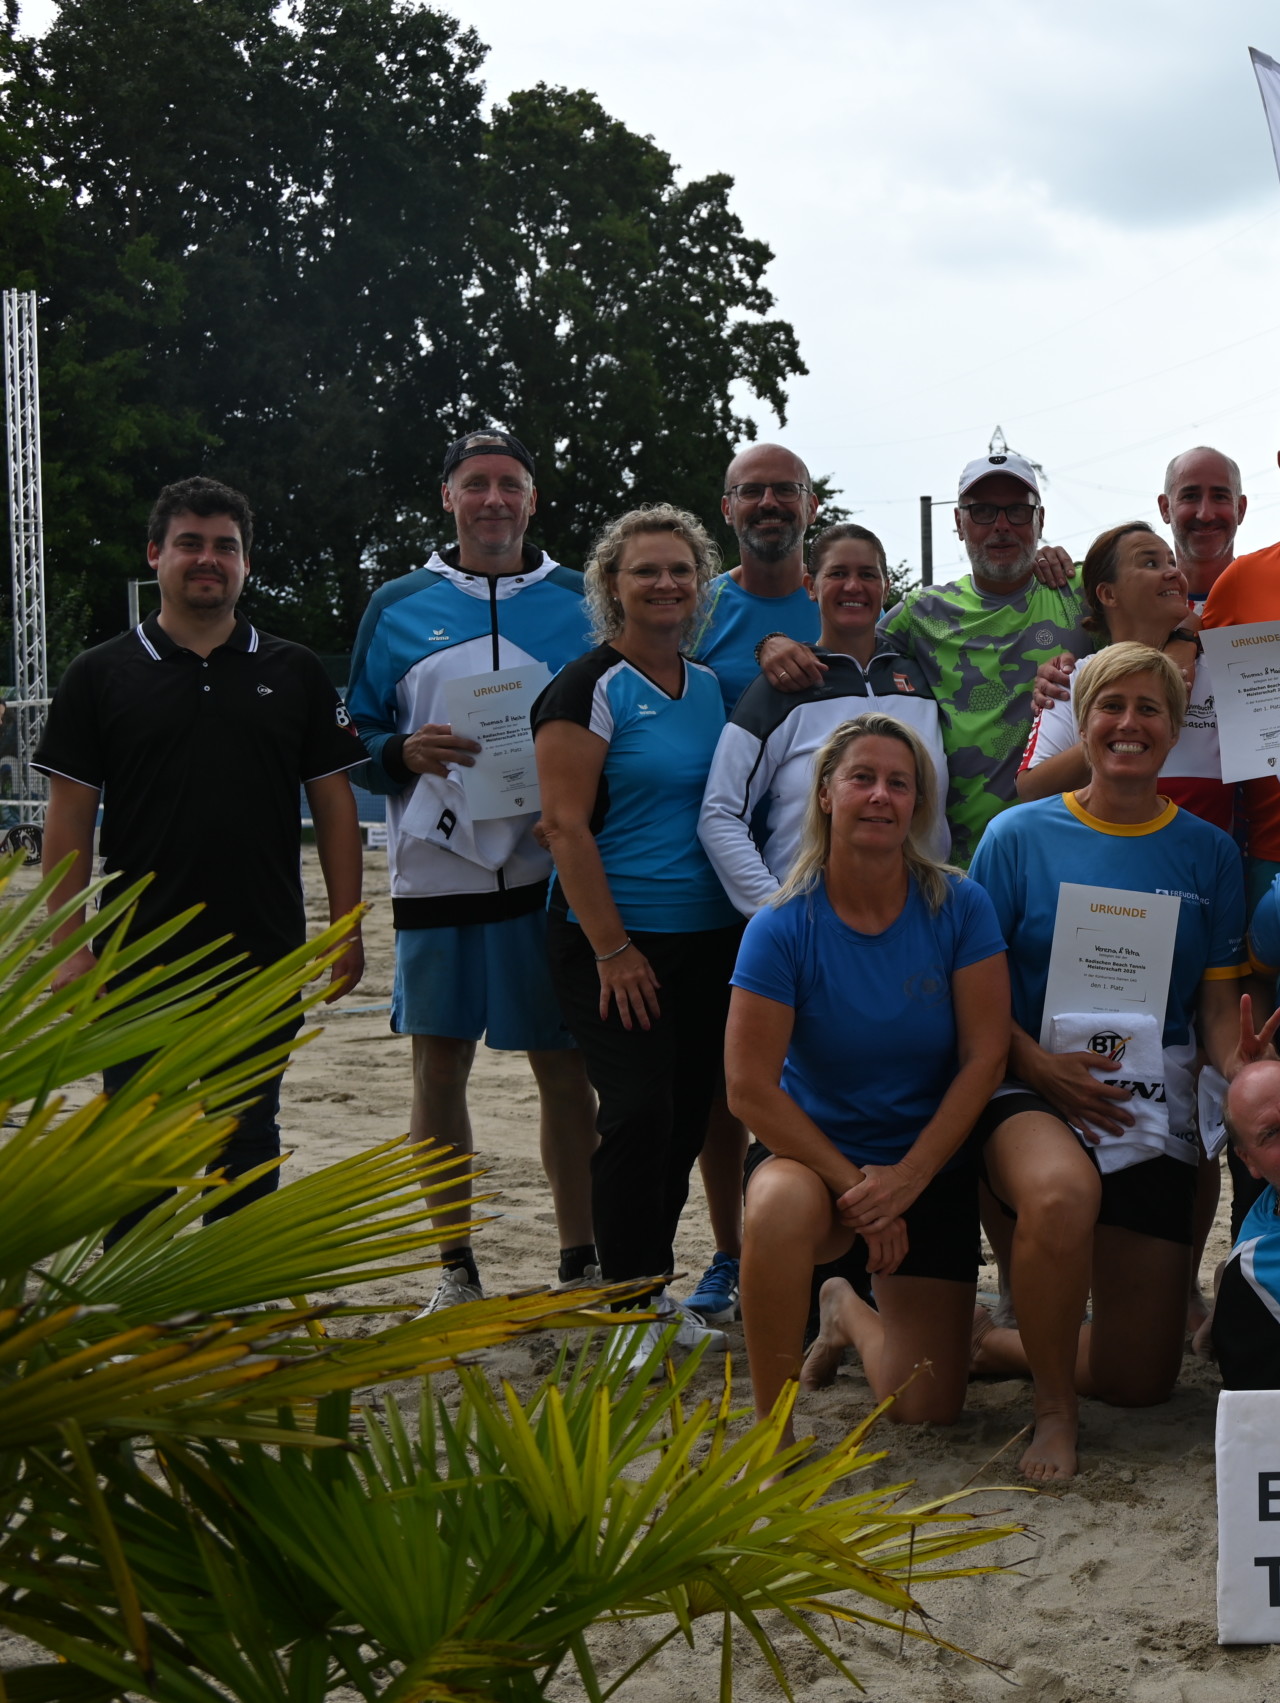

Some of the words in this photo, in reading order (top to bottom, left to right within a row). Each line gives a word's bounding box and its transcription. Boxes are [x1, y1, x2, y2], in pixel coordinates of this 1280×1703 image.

[1240, 672, 1264, 680] Thomas
[474, 680, 522, 698] URKUNDE
[1090, 904, 1147, 918] URKUNDE
[1095, 945, 1117, 954] Verena
[1125, 948, 1140, 956] Petra
[1085, 958, 1111, 966] Badischen
[1088, 964, 1122, 972] Meisterschaft
[1092, 1036, 1121, 1054] BT
